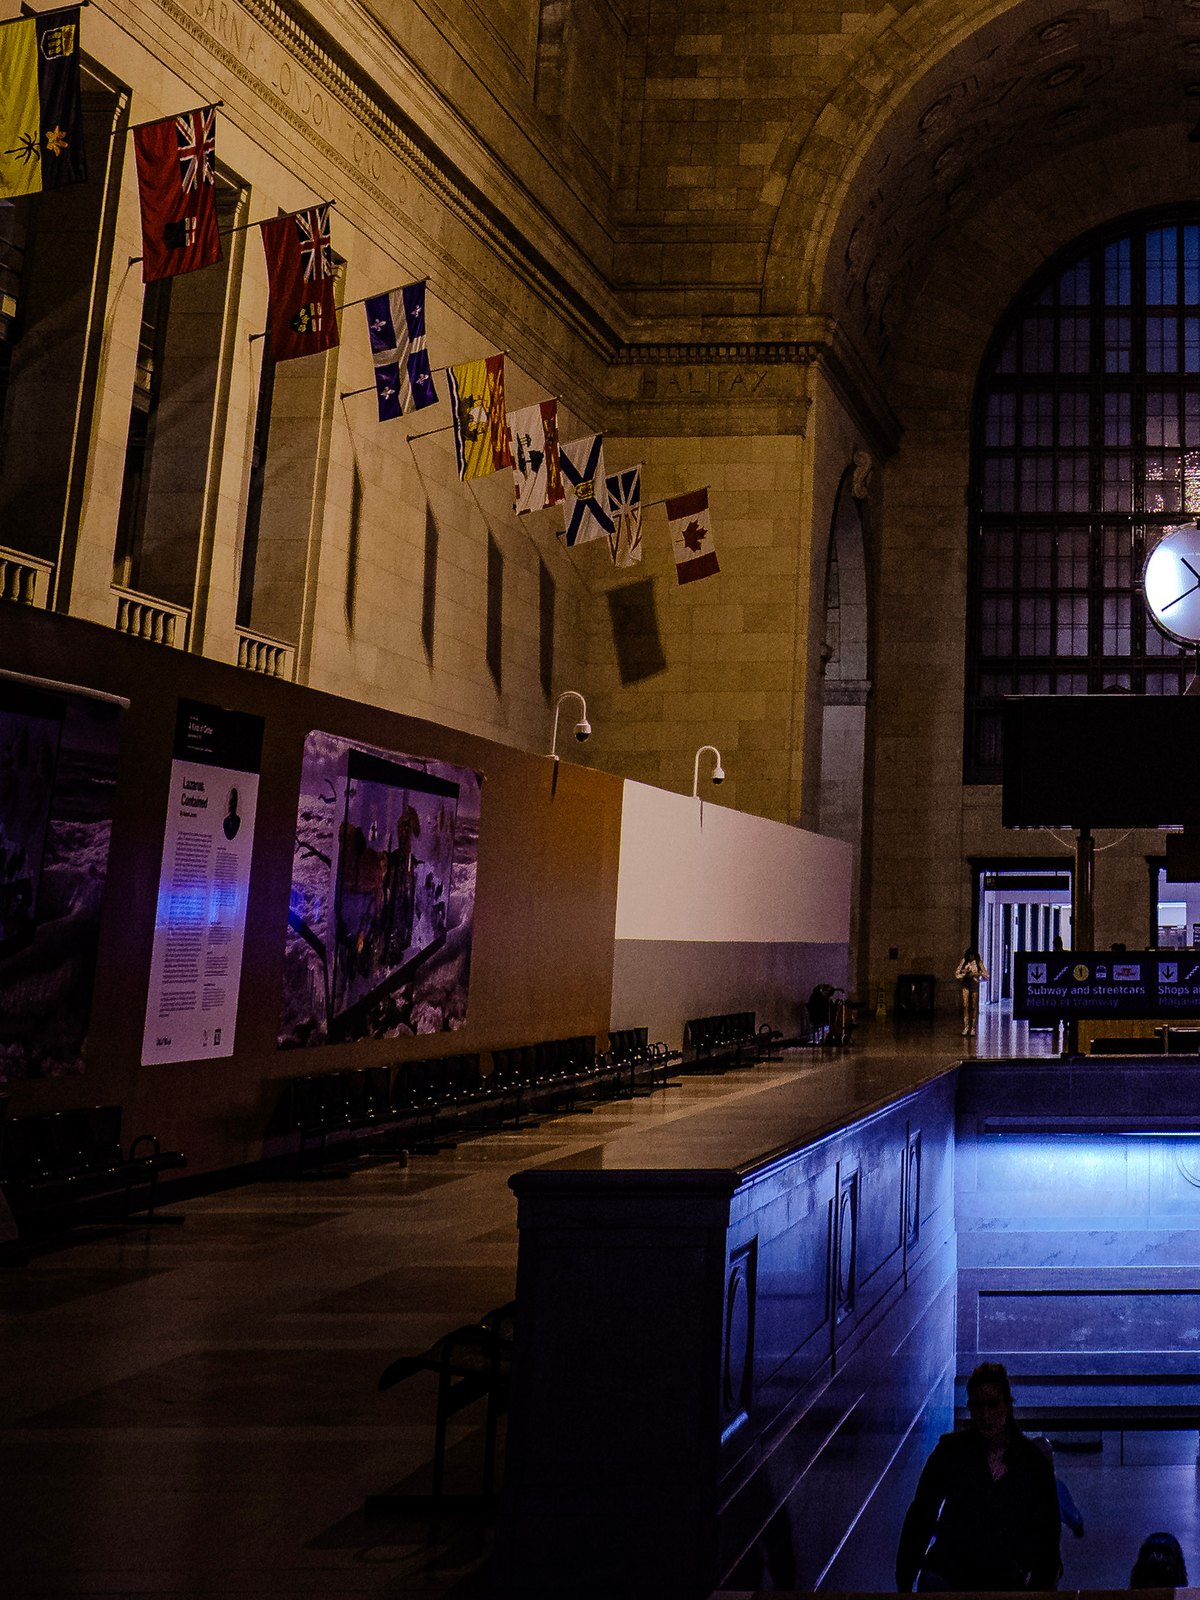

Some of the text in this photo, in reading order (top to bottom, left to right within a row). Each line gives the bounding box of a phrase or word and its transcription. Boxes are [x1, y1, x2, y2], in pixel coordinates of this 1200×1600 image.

[639, 370, 769, 395] HALIFAX
[1026, 985, 1146, 998] Subway and streetcars
[1157, 984, 1190, 997] Shops
